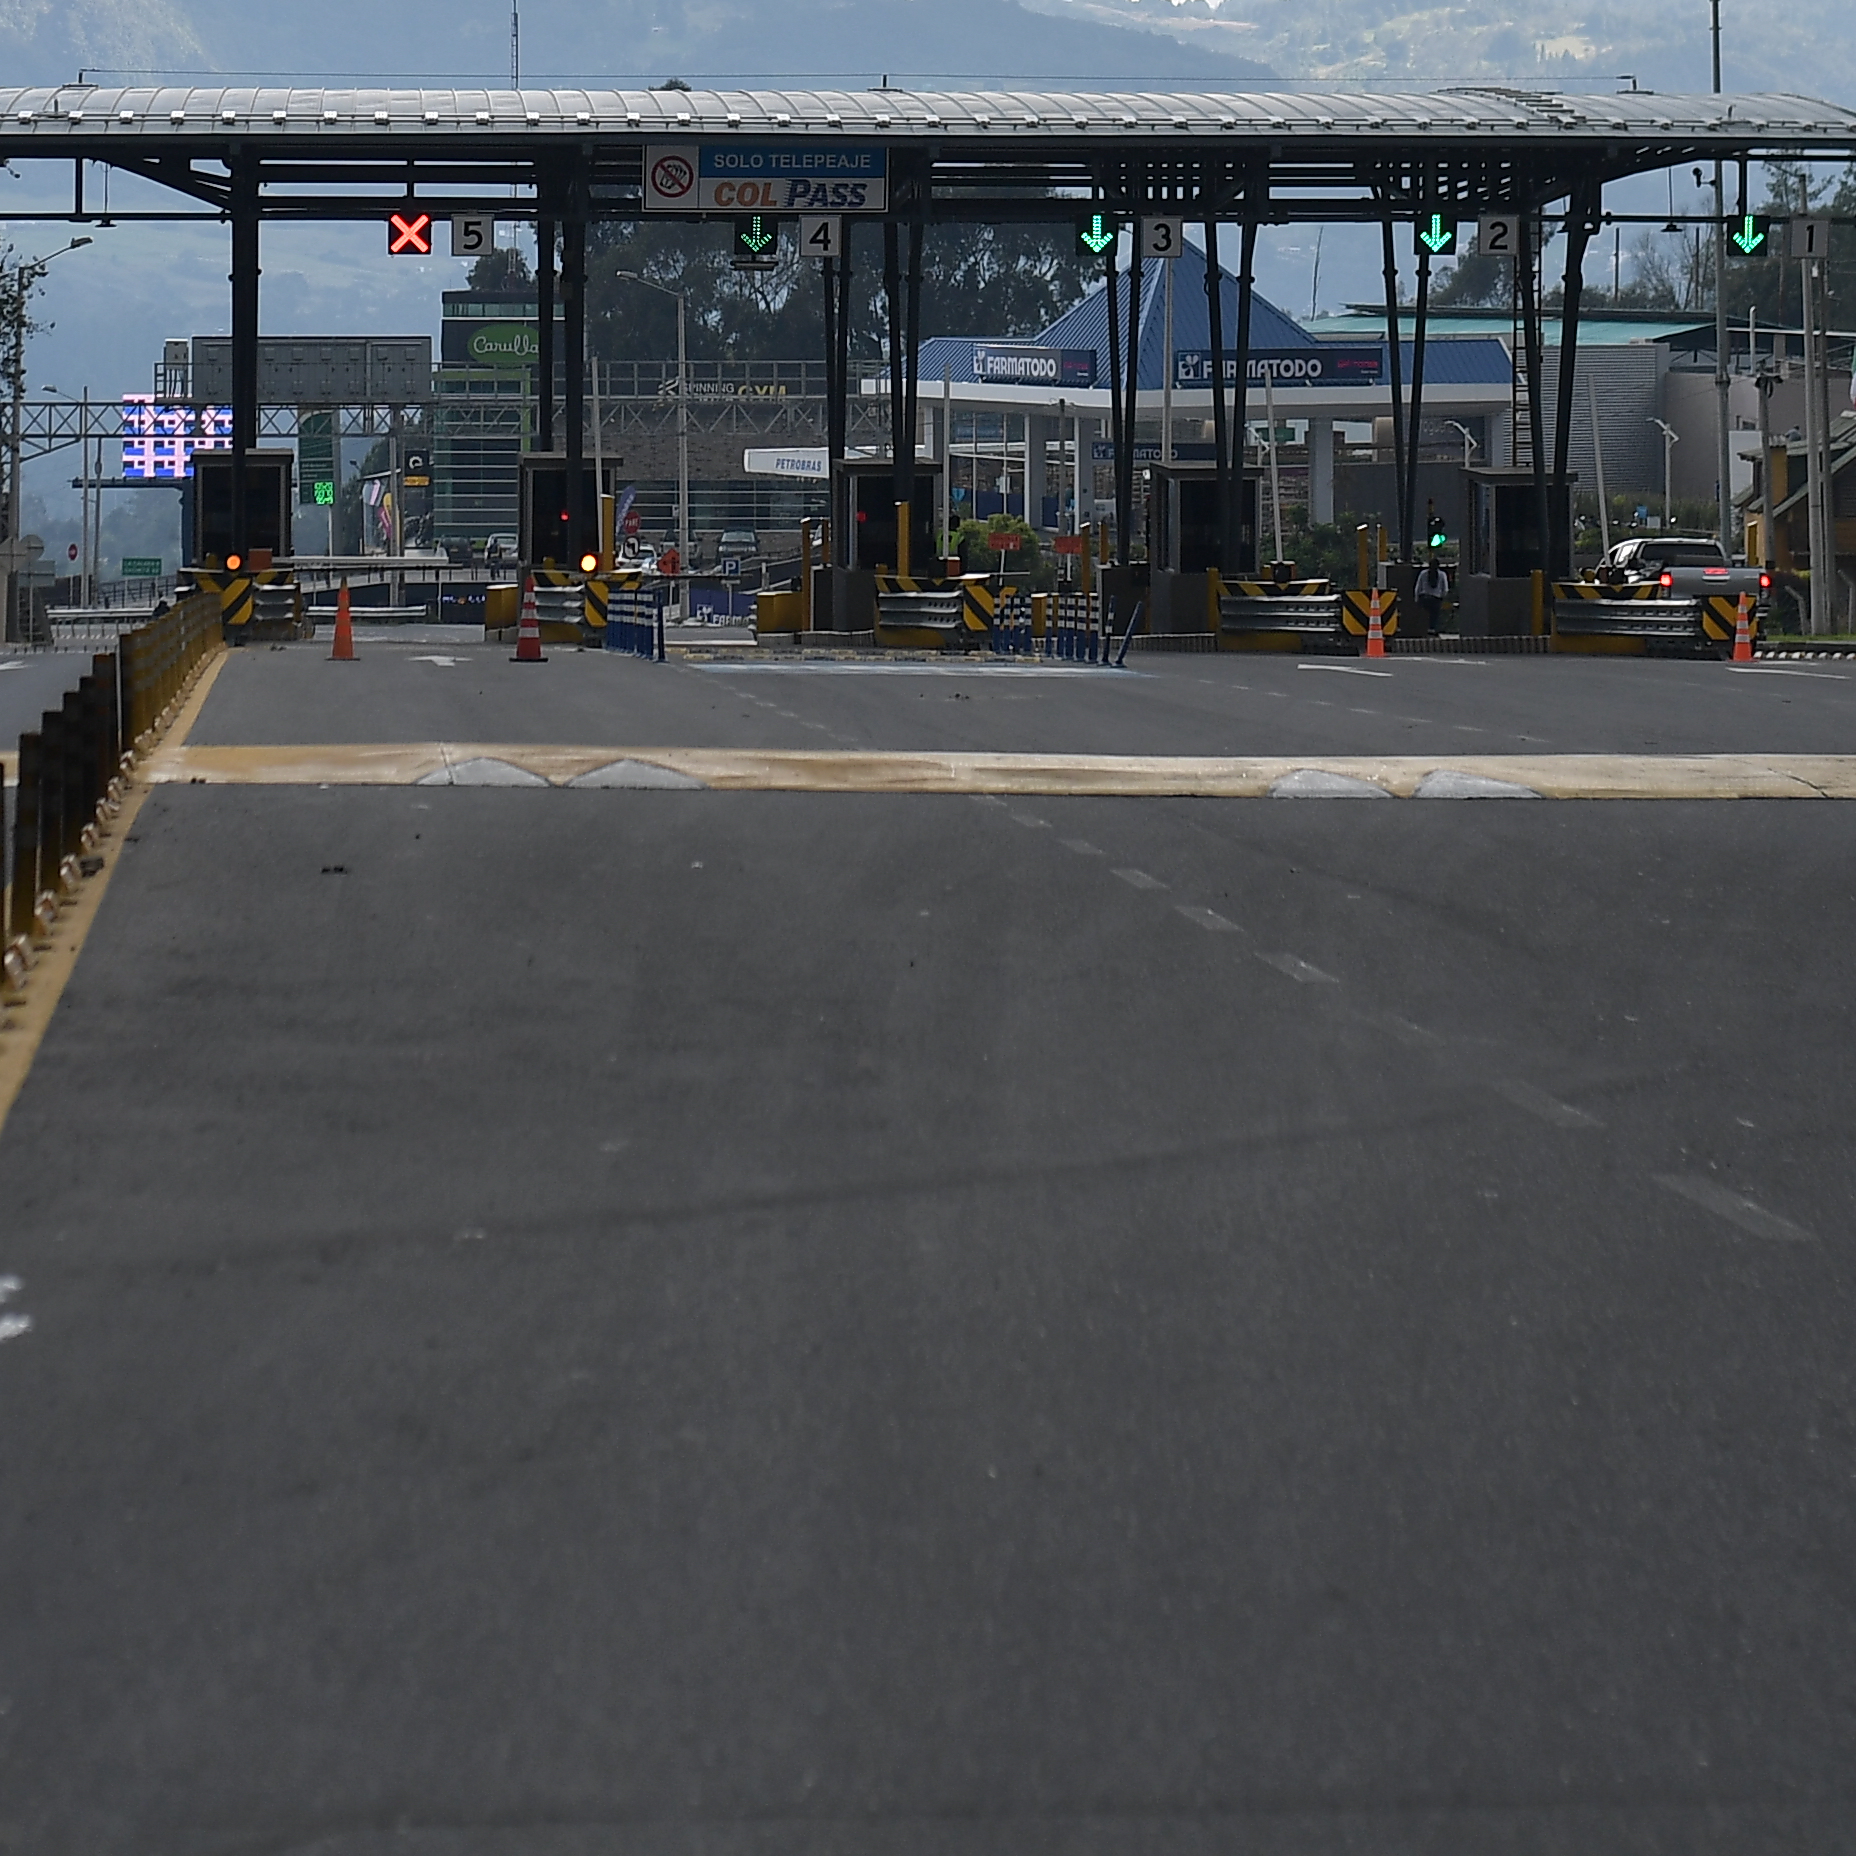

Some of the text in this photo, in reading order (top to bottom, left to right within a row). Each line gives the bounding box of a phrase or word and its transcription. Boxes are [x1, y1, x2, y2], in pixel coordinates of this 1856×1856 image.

[713, 154, 872, 169] SOLO TELEPEAJE
[461, 220, 484, 250] 5
[809, 221, 832, 252] 4
[1151, 221, 1173, 252] 3
[1488, 221, 1510, 251] 2
[1804, 223, 1815, 252] 1
[473, 335, 539, 356] Carulla
[986, 356, 1056, 377] FARMATODO
[685, 382, 734, 394] SPINNING
[775, 458, 823, 472] PETROBRAS
[725, 561, 736, 575] P
